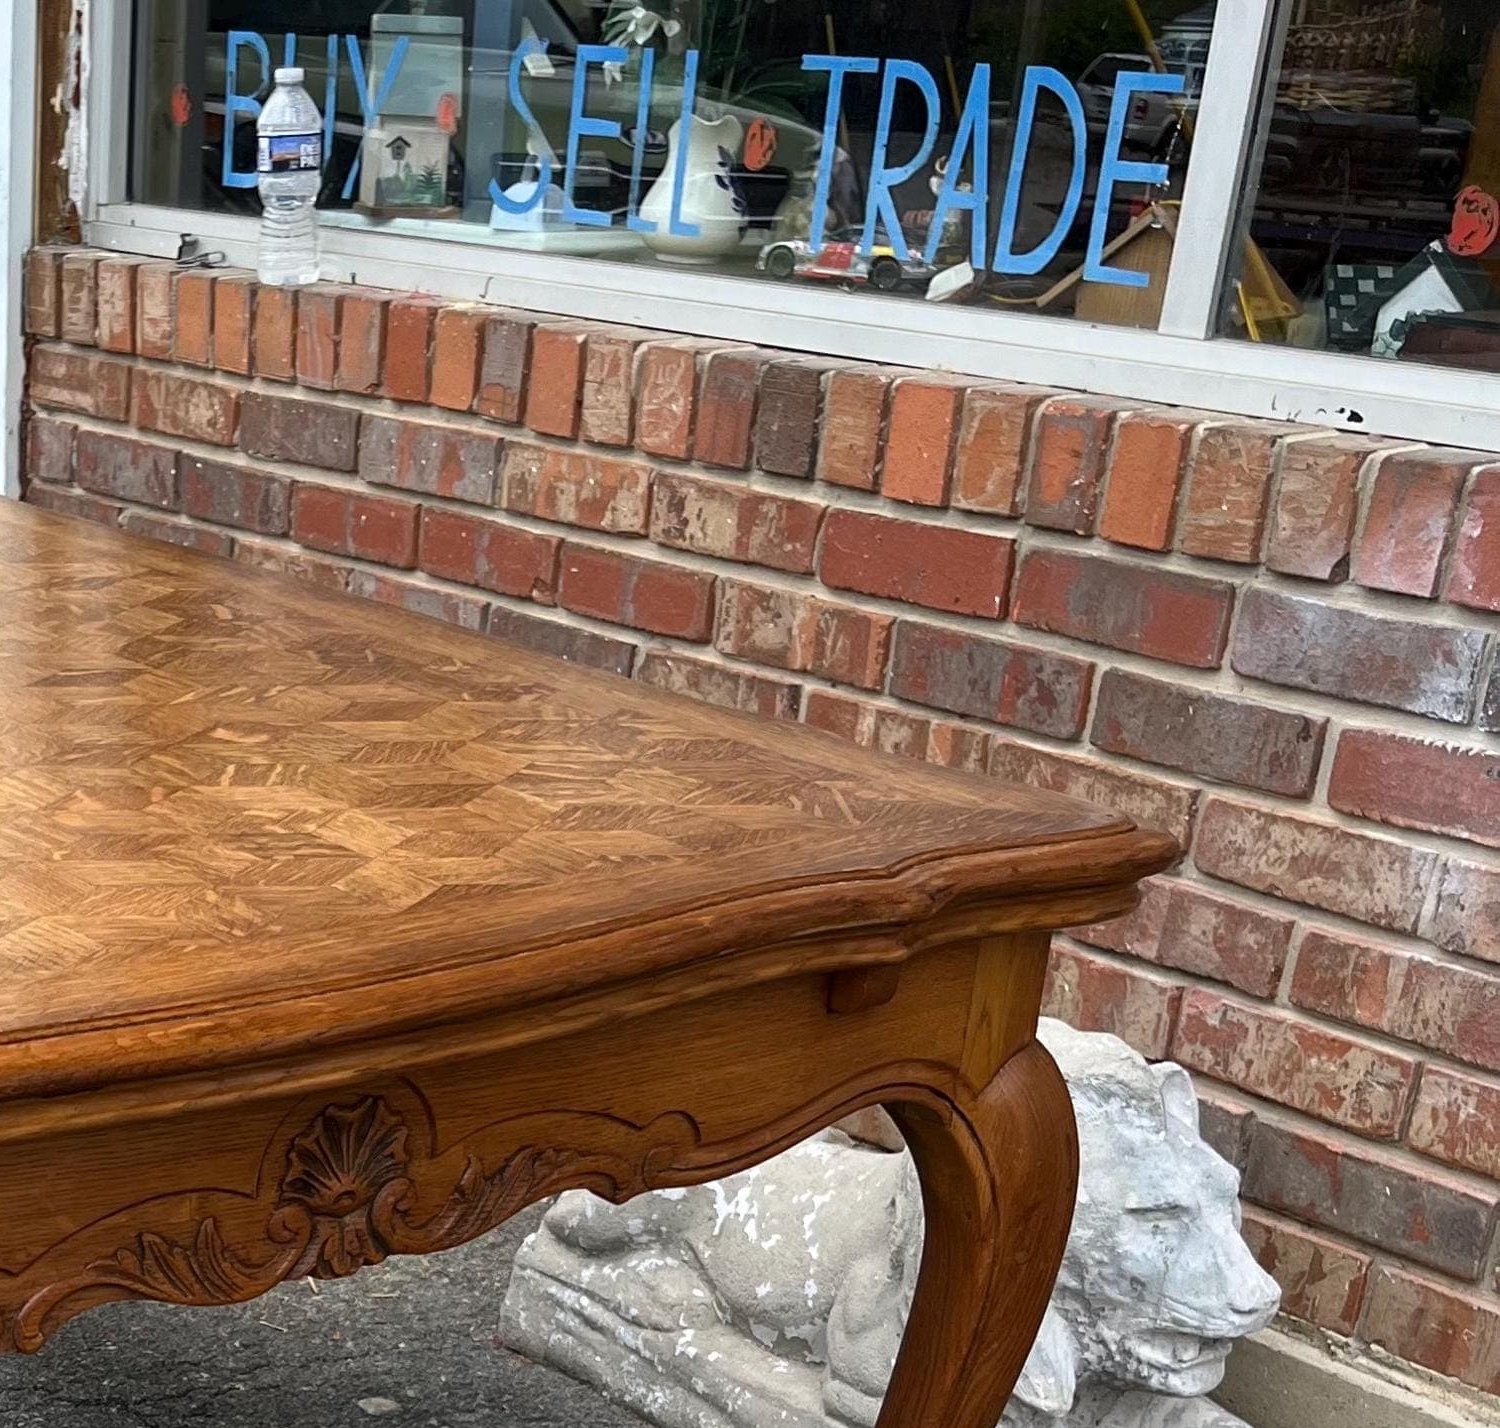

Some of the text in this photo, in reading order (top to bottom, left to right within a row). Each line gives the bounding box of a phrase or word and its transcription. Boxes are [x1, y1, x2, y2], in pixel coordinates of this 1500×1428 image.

[222, 30, 1185, 288] BUY SELL TRADE
